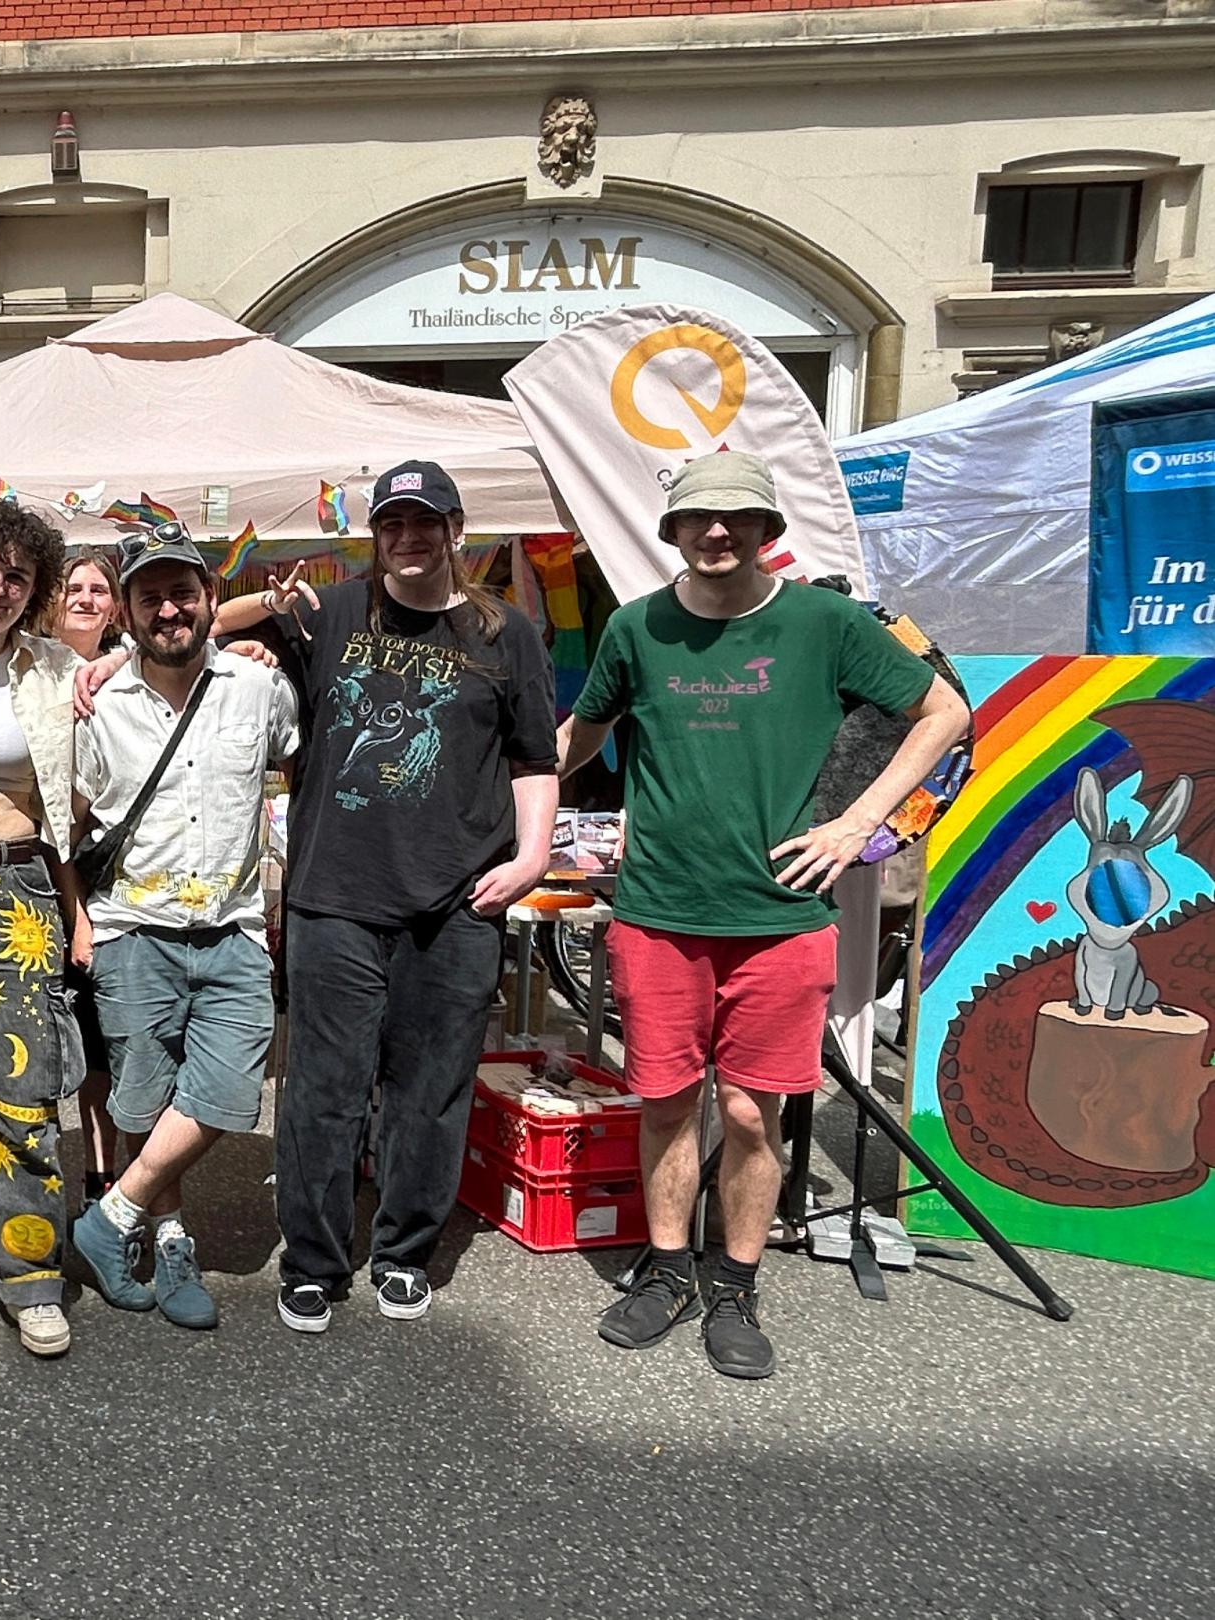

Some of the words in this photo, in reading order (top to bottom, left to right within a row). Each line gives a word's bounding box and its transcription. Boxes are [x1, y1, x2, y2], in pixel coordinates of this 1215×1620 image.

[459, 236, 643, 295] SIAM
[409, 305, 542, 328] Thailändische
[1165, 451, 1215, 467] WEISS
[1147, 556, 1206, 585] Im
[1120, 595, 1185, 634] für
[350, 632, 407, 650] DOCTOR
[340, 641, 466, 686] PLEASE
[696, 698, 730, 714] 2023
